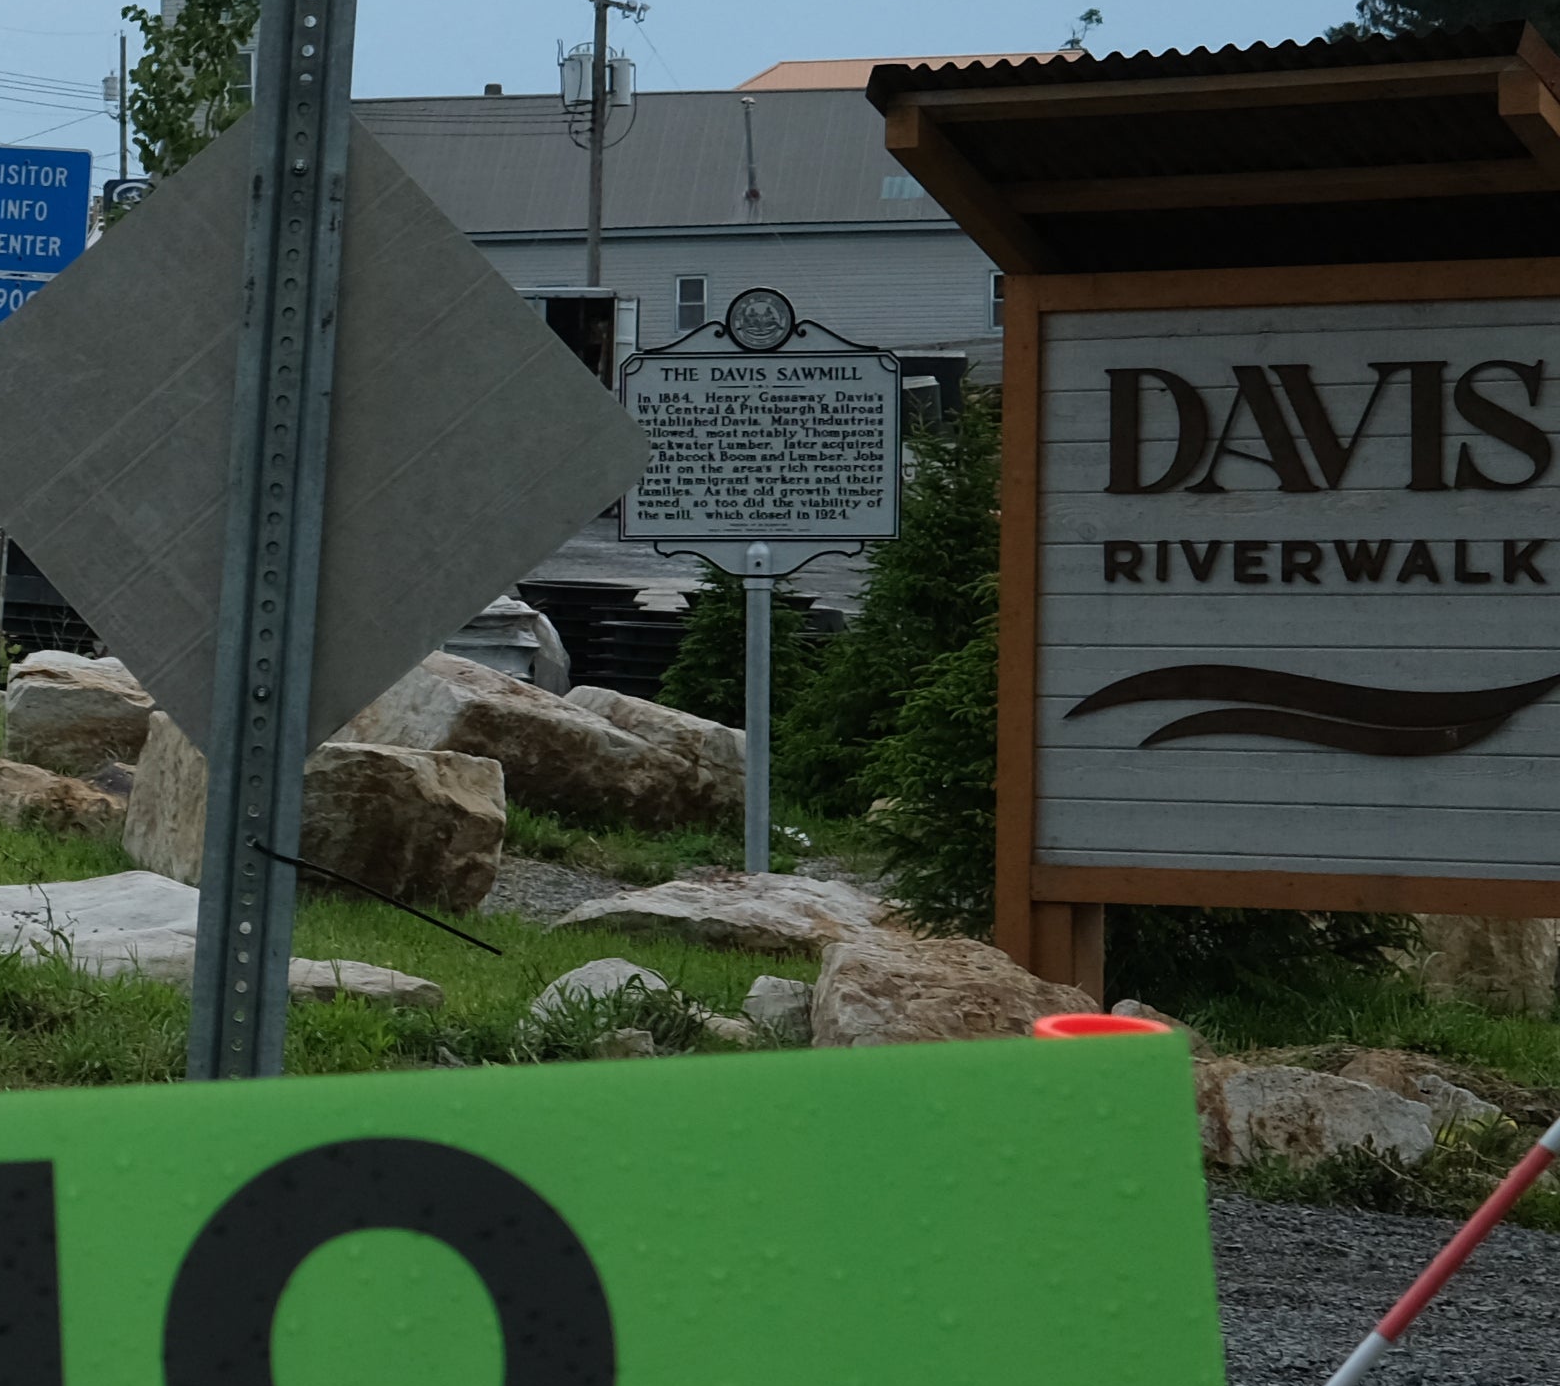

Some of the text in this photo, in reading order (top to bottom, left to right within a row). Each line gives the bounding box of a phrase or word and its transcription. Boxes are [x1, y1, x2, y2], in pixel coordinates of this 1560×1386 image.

[0, 199, 48, 221] INFO
[660, 366, 862, 381] THE DAVIS SAWMILL
[637, 392, 651, 403] In
[705, 392, 751, 405] Henry
[759, 391, 826, 404] Gassaway
[638, 405, 660, 414] WV
[665, 404, 720, 414] Central
[740, 403, 815, 416] Pittsburgh
[820, 403, 883, 414] Railroad
[637, 416, 718, 426] established
[771, 415, 809, 429] Many
[812, 415, 884, 425] industries
[1103, 359, 1552, 495] DAVIS
[705, 428, 737, 438] most
[741, 428, 797, 440] notably
[783, 439, 817, 449] later
[821, 438, 884, 451] acquired
[658, 451, 716, 461] Babcock
[720, 451, 757, 461] Boom
[760, 451, 784, 461] and
[853, 450, 884, 461] Jobs
[677, 465, 694, 473] on
[701, 464, 723, 473] the
[780, 463, 807, 472] rich
[813, 464, 884, 472] resources
[677, 475, 749, 487] immigrant
[755, 475, 810, 484] workers
[815, 474, 840, 484] and
[846, 474, 883, 484] their
[704, 486, 721, 496] As
[726, 486, 748, 496] the
[753, 486, 774, 496] old
[780, 486, 830, 498] growth
[837, 486, 884, 496] timber
[693, 499, 708, 508] so
[715, 499, 738, 508] too
[743, 498, 764, 508] did
[772, 497, 794, 507] the
[801, 497, 860, 509] viability
[866, 497, 882, 507] of
[637, 510, 659, 520] the
[704, 510, 744, 520] which
[748, 509, 791, 520] closed
[797, 510, 810, 519] in
[1103, 539, 1548, 585] RIVERWALK
